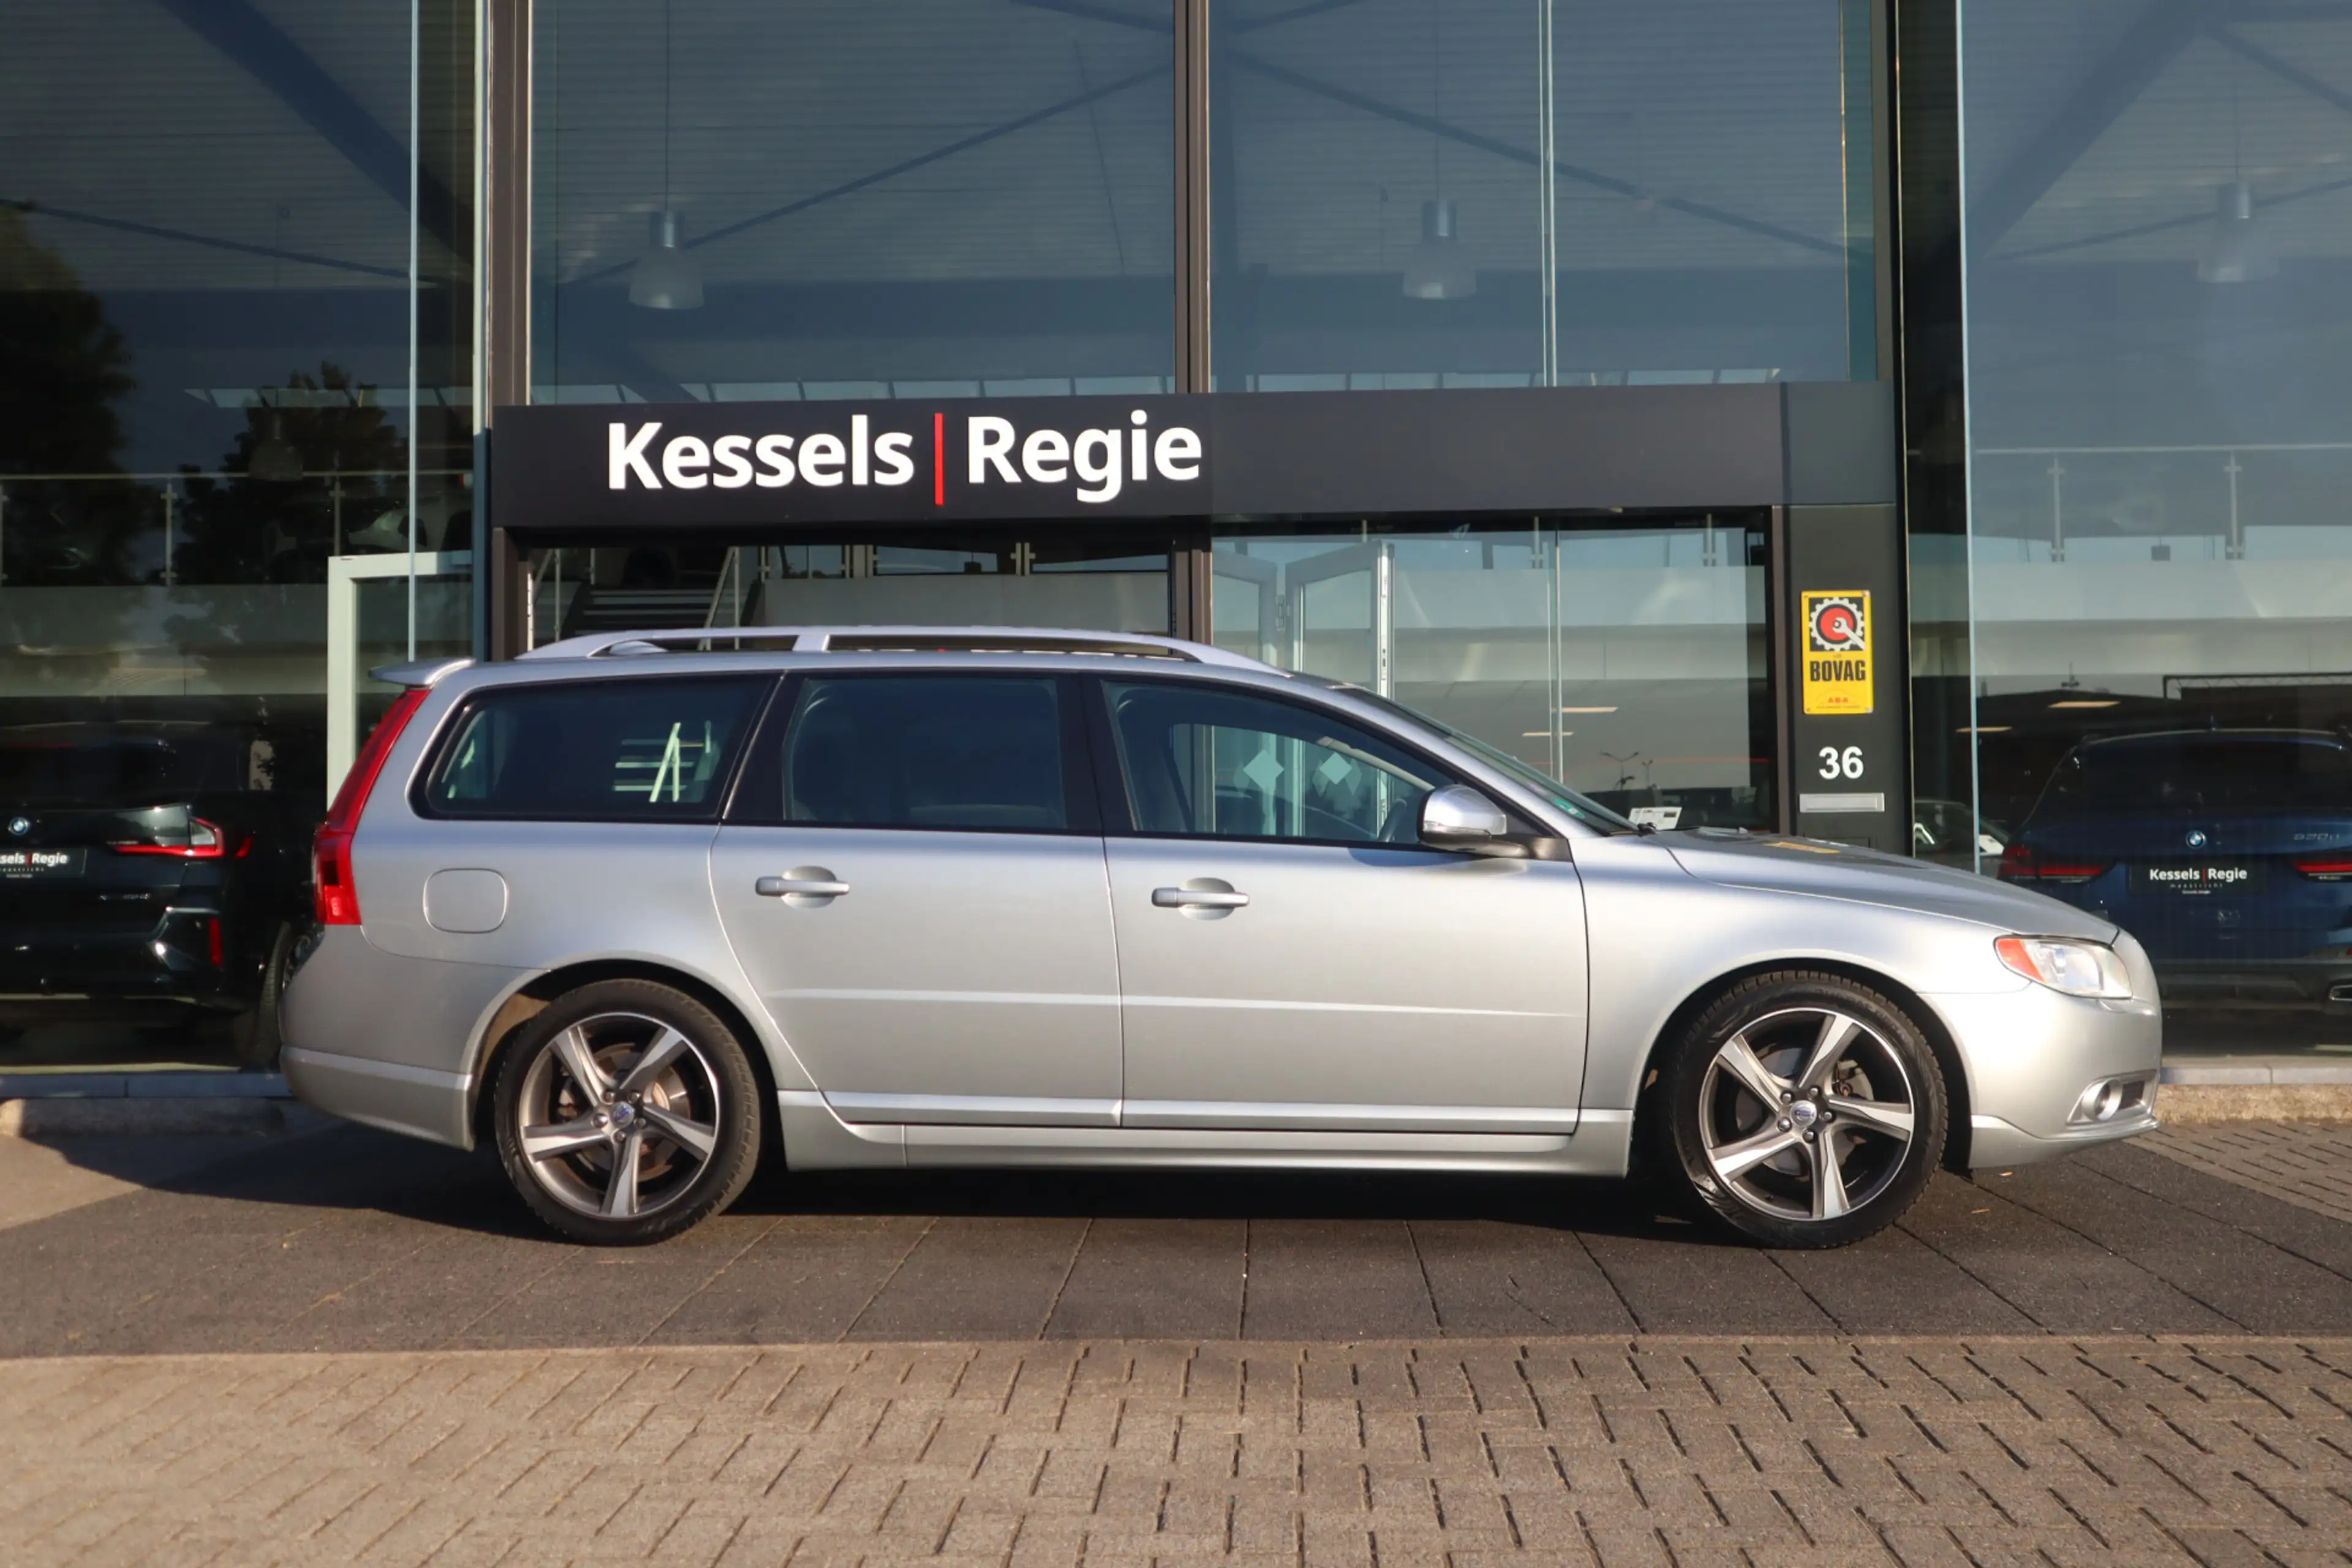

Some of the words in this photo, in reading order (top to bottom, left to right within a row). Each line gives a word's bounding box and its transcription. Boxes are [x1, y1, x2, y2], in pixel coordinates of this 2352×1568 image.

[609, 415, 915, 490] Kessels
[968, 409, 1202, 503] Regie
[1810, 660, 1866, 682] BOVAG
[1819, 745, 1864, 780] 36
[31, 852, 69, 867] Regie
[2149, 867, 2200, 881] Kessels
[2207, 867, 2248, 883] Regie
